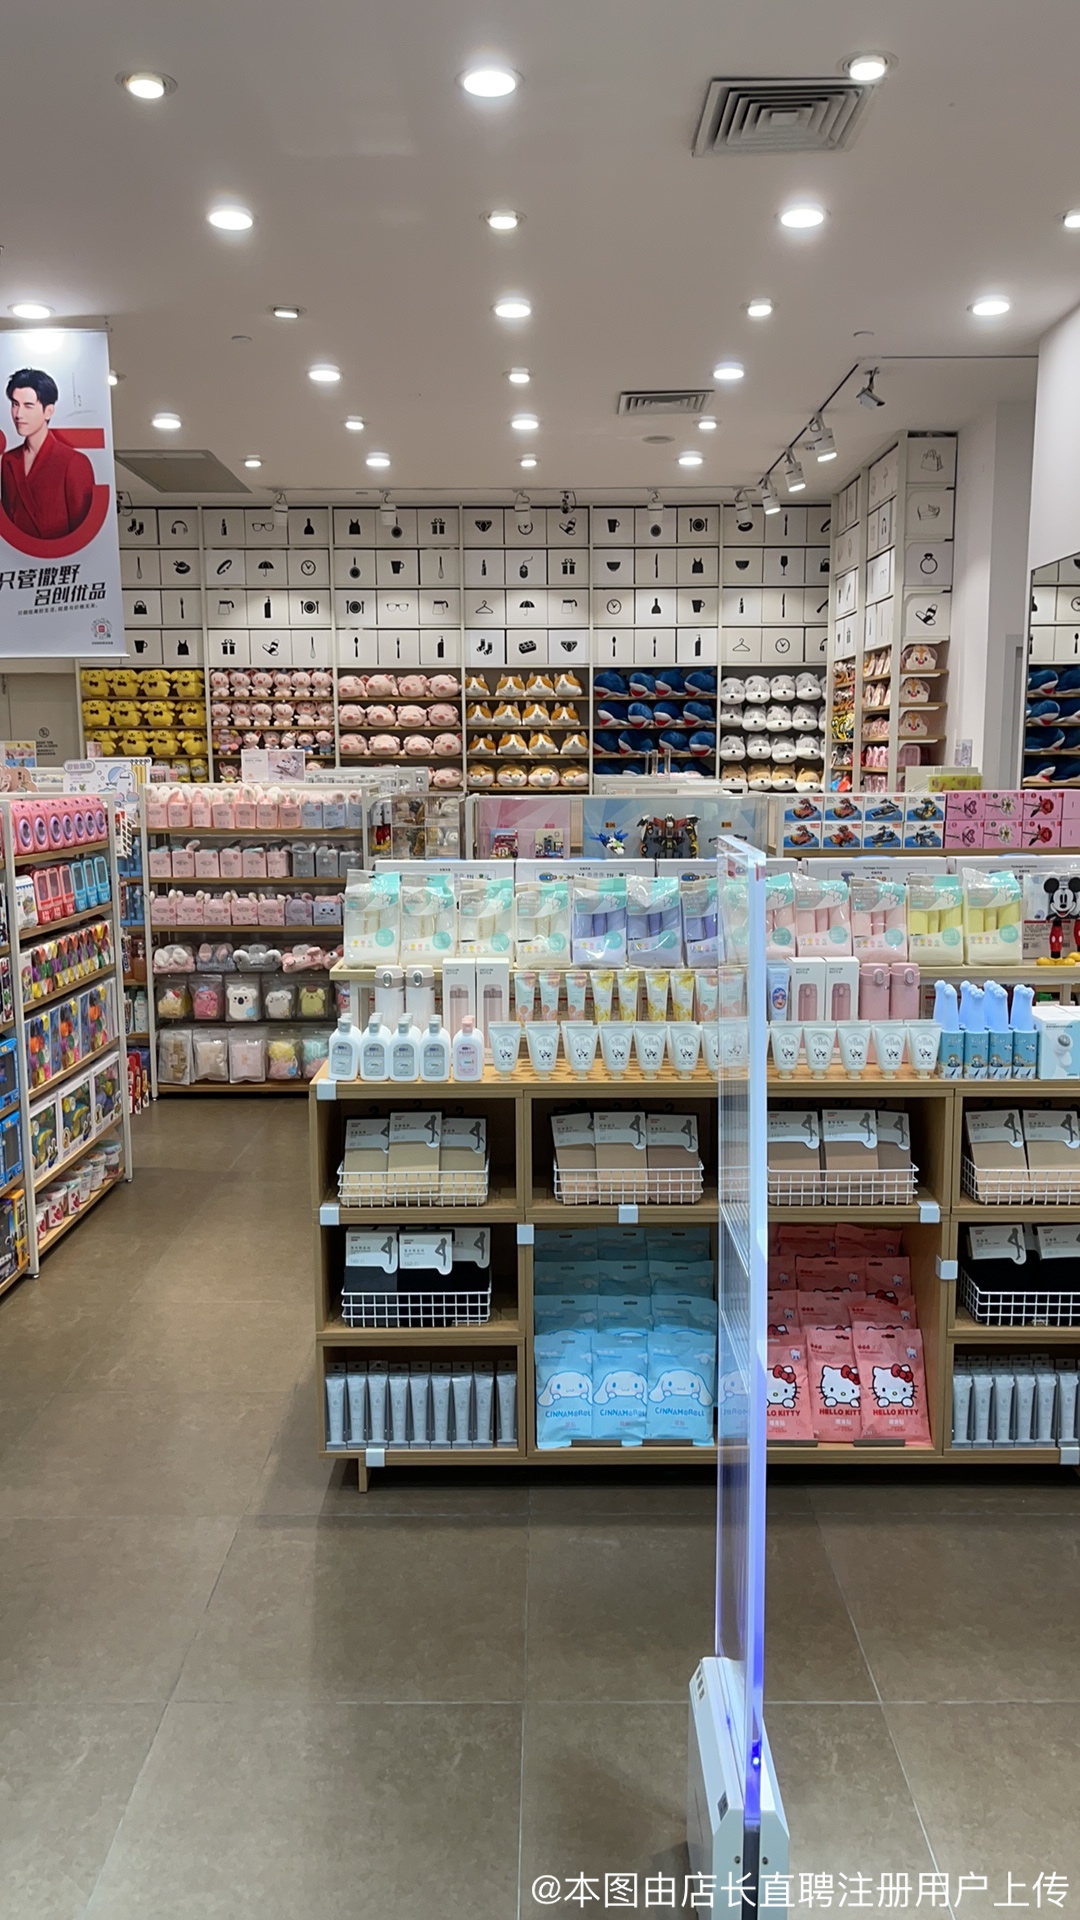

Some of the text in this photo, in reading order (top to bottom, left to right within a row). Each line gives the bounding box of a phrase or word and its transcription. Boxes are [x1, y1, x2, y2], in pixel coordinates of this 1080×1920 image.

[0, 564, 81, 591] 只管撒野
[34, 582, 107, 607] 名创优品
[545, 1409, 592, 1418] CINNAMOROL
[599, 1408, 647, 1417] CINNAMOROL
[654, 1406, 706, 1417] CINNAMOROLL
[819, 1408, 844, 1416] HELLO
[872, 1408, 920, 1416] HELLO KITTY
